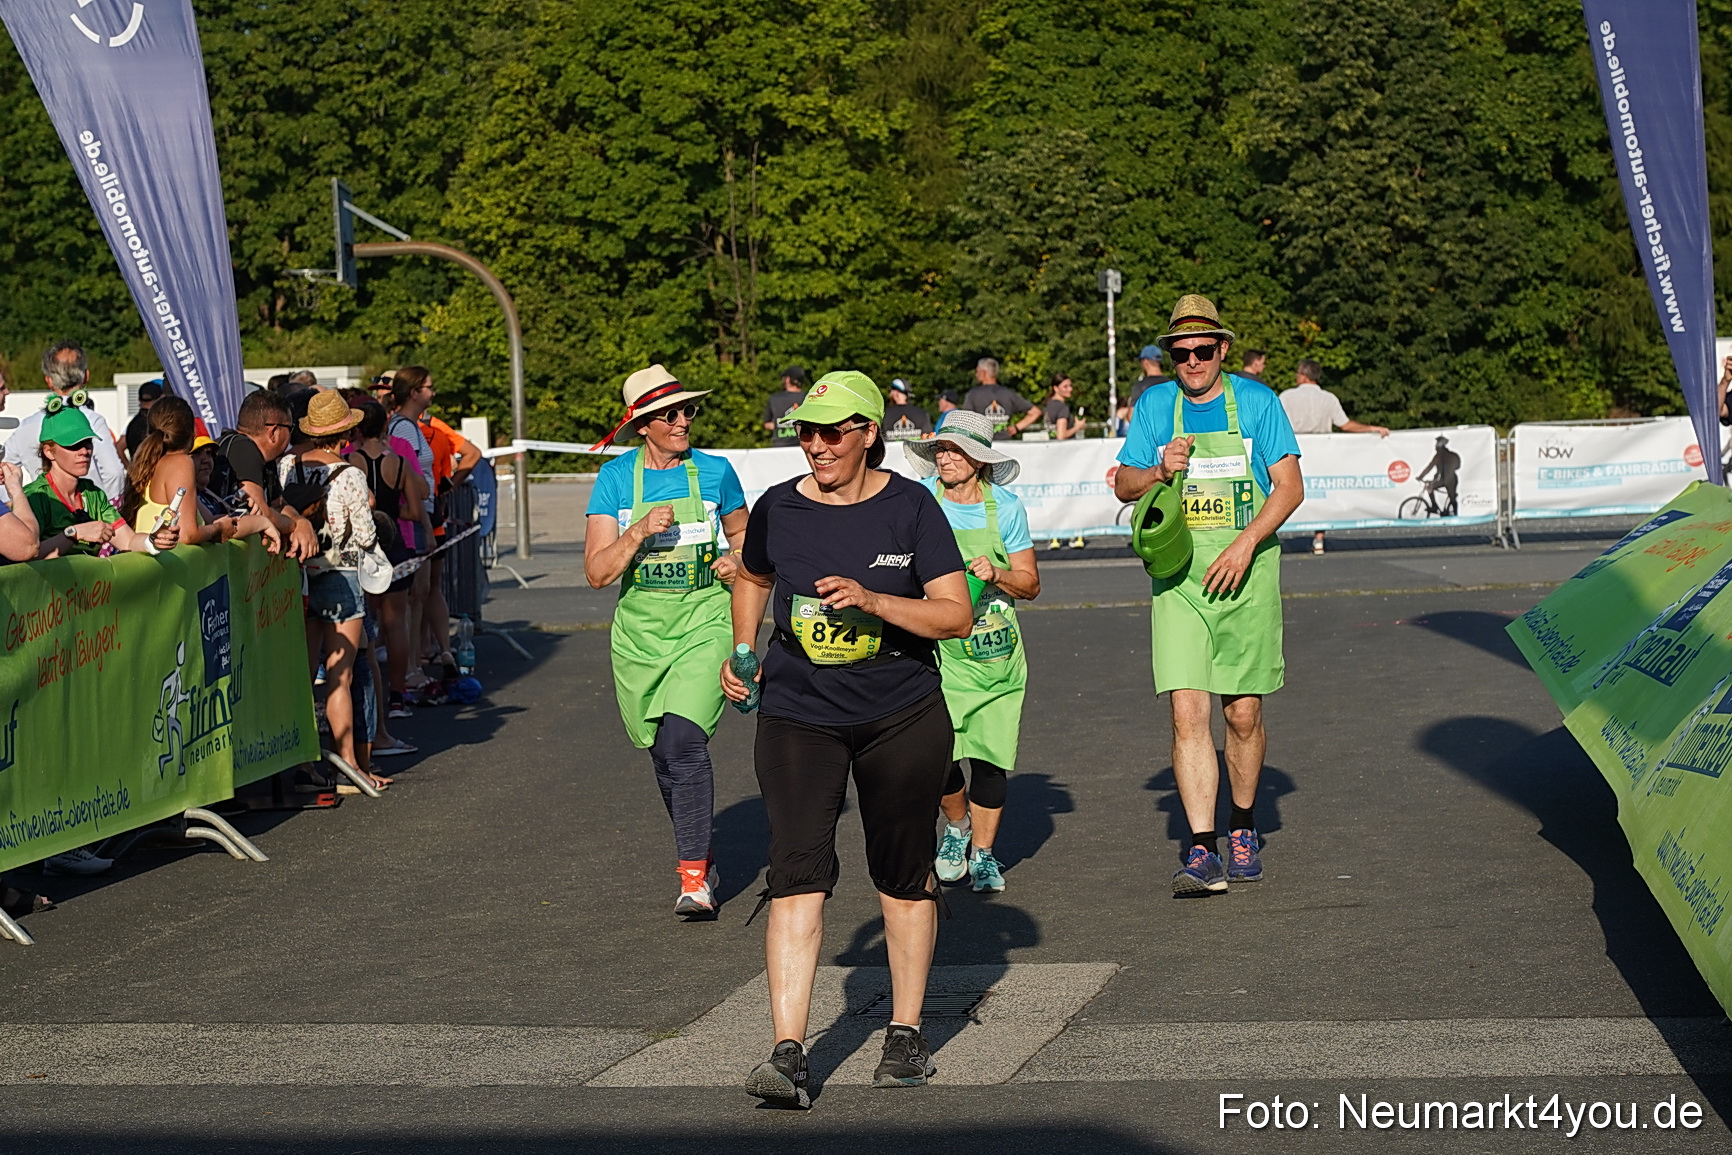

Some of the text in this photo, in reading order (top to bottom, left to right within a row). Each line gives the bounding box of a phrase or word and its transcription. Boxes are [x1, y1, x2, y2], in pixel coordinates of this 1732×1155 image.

[1538, 446, 1574, 459] NOW
[1539, 467, 1592, 480] E-BIKES
[1181, 498, 1224, 515] 1446
[641, 562, 687, 578] 1438
[687, 563, 695, 585] 2022
[6, 580, 112, 652] Gesunde Firmen
[796, 620, 804, 641] ALK
[811, 621, 859, 645] 874
[971, 627, 1010, 650] 1437
[37, 607, 121, 690] laufen länger!
[866, 630, 877, 656] 2022
